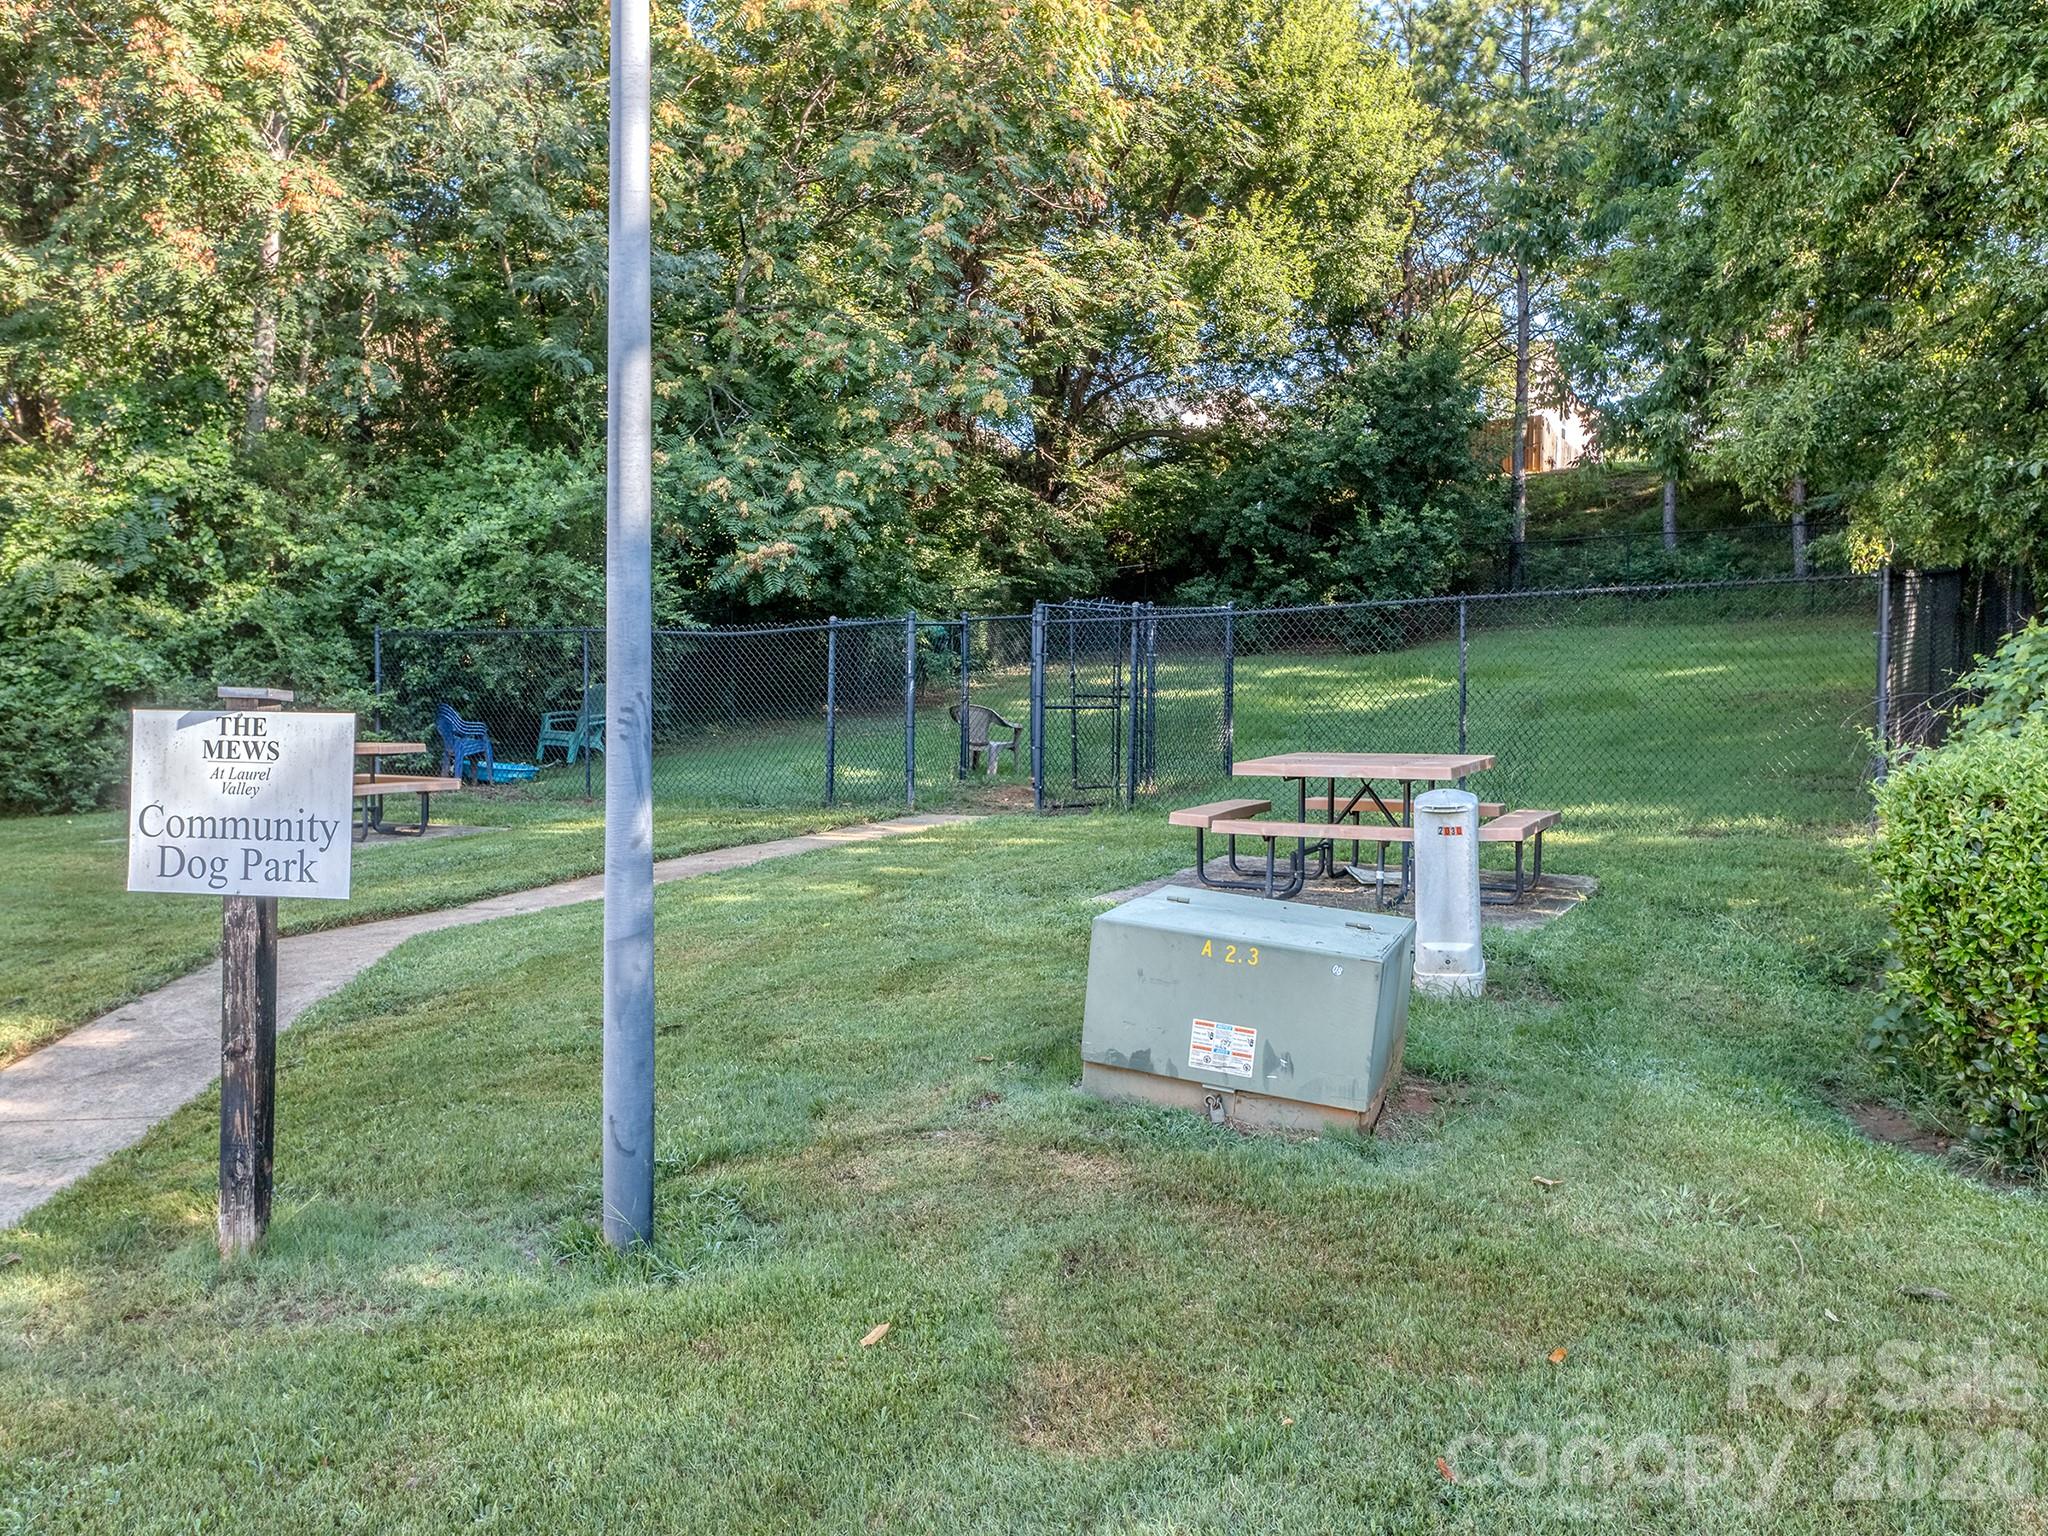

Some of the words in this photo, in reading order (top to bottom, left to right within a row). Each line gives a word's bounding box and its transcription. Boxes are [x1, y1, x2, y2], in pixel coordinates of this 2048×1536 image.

[216, 716, 267, 737] THE
[202, 739, 280, 761] MEWS
[209, 767, 224, 780] At
[228, 767, 272, 781] Laurel
[221, 782, 261, 799] Valley
[138, 803, 340, 852] Community
[156, 845, 229, 889] Dog
[239, 848, 319, 884] Park
[1201, 939, 1212, 958] A
[1224, 944, 1259, 966] 2.3
